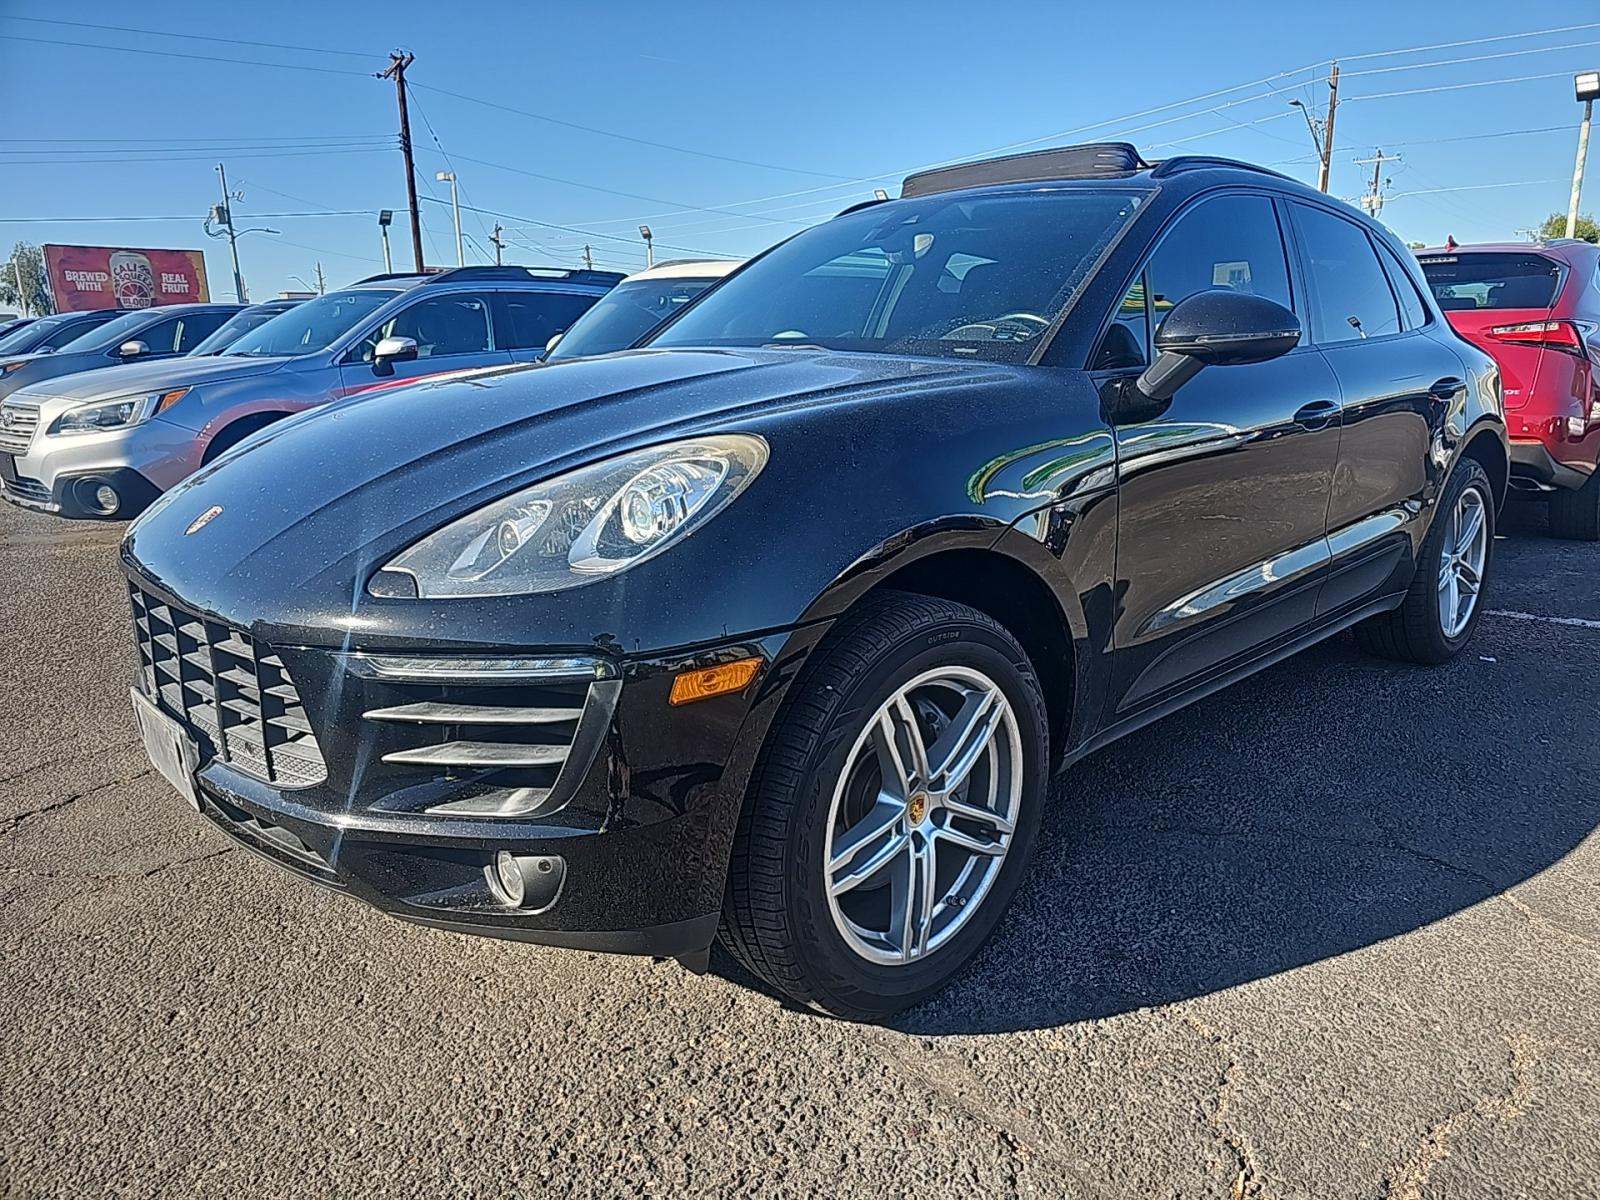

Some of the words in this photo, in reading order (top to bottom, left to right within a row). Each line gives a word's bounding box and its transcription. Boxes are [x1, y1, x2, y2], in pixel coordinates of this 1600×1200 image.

[113, 263, 137, 276] CALI
[64, 270, 109, 282] BREWED
[161, 273, 188, 284] REAL
[75, 280, 103, 292] WITH
[160, 283, 190, 294] FRUIT
[927, 631, 961, 645] OUTSIDE
